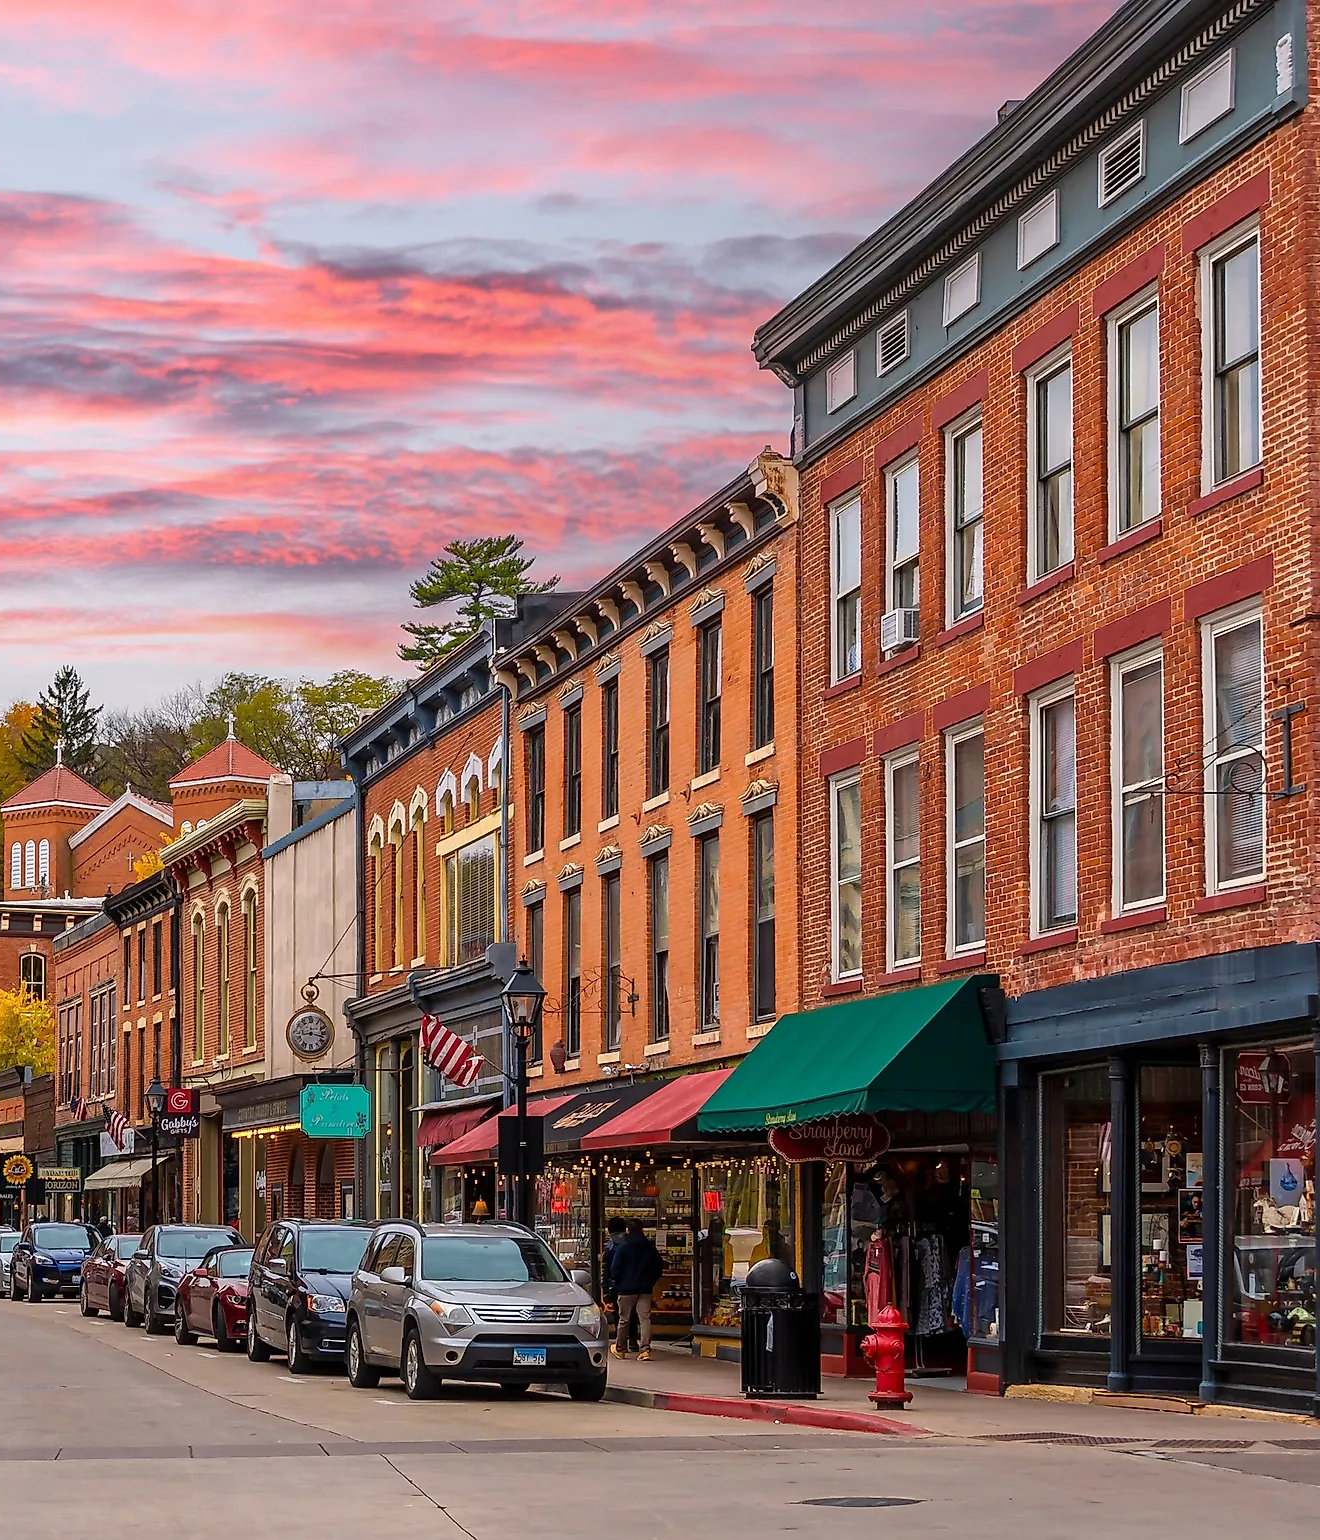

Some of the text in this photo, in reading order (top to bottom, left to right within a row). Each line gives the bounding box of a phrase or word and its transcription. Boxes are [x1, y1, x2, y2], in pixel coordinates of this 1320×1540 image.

[319, 1088, 349, 1101] Petals
[160, 1116, 199, 1134] Gabby's
[789, 1119, 874, 1149] Strawberry
[823, 1137, 864, 1157] Lane
